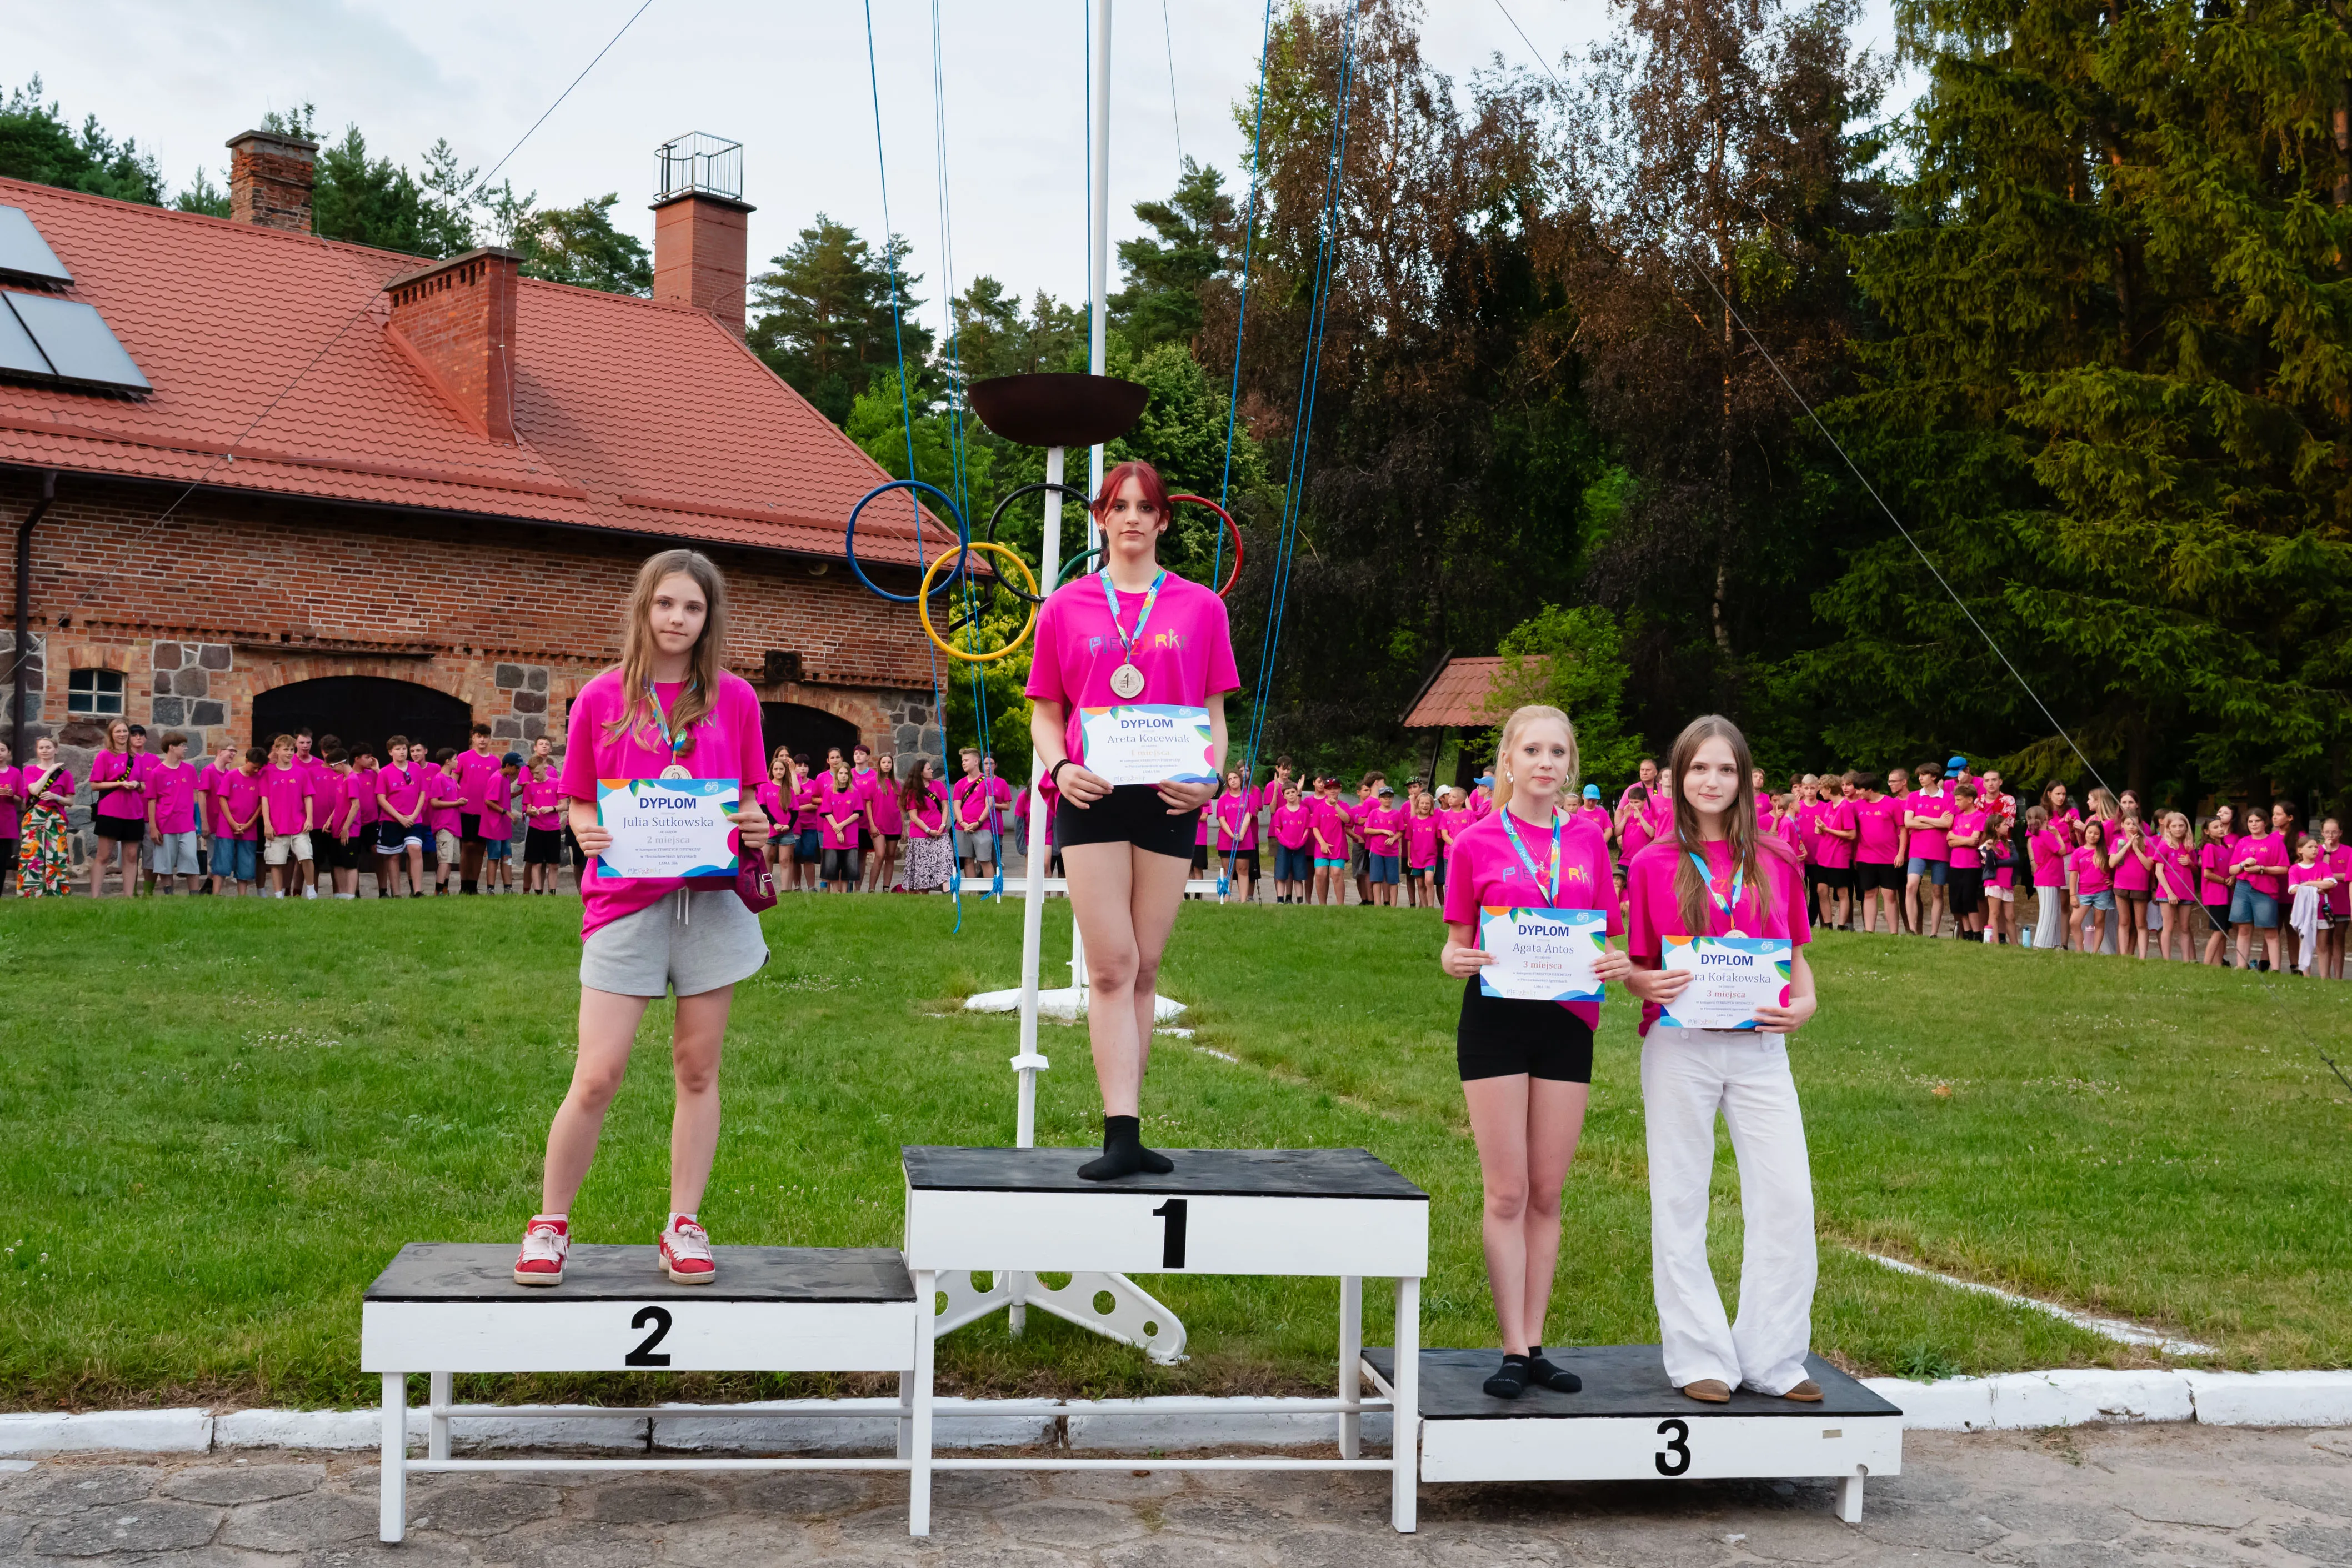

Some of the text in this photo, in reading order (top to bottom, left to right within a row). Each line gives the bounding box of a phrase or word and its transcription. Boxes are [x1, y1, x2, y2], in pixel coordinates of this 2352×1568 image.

[1121, 719, 1173, 728] DYPLOM
[1139, 734, 1190, 743] Kocewiak
[705, 782, 718, 791] 65
[640, 798, 697, 809] DYPLOM
[623, 816, 714, 829] Julia Sutkowska
[655, 836, 690, 845] miejsca
[1503, 864, 1593, 888] PIEZRKI
[1577, 912, 1589, 921] 65
[1518, 925, 1569, 937] DYPLOM
[1513, 943, 1574, 955] Agata Antos
[1761, 941, 1774, 950] 65
[1701, 954, 1753, 966] DYPLOM
[1530, 961, 1562, 970] miejsca
[1709, 973, 1770, 983] Kołakowska
[1714, 991, 1745, 999] miejsca
[1153, 1199, 1187, 1269] 1
[625, 1306, 672, 1366] 2
[1655, 1419, 1690, 1476] 3
